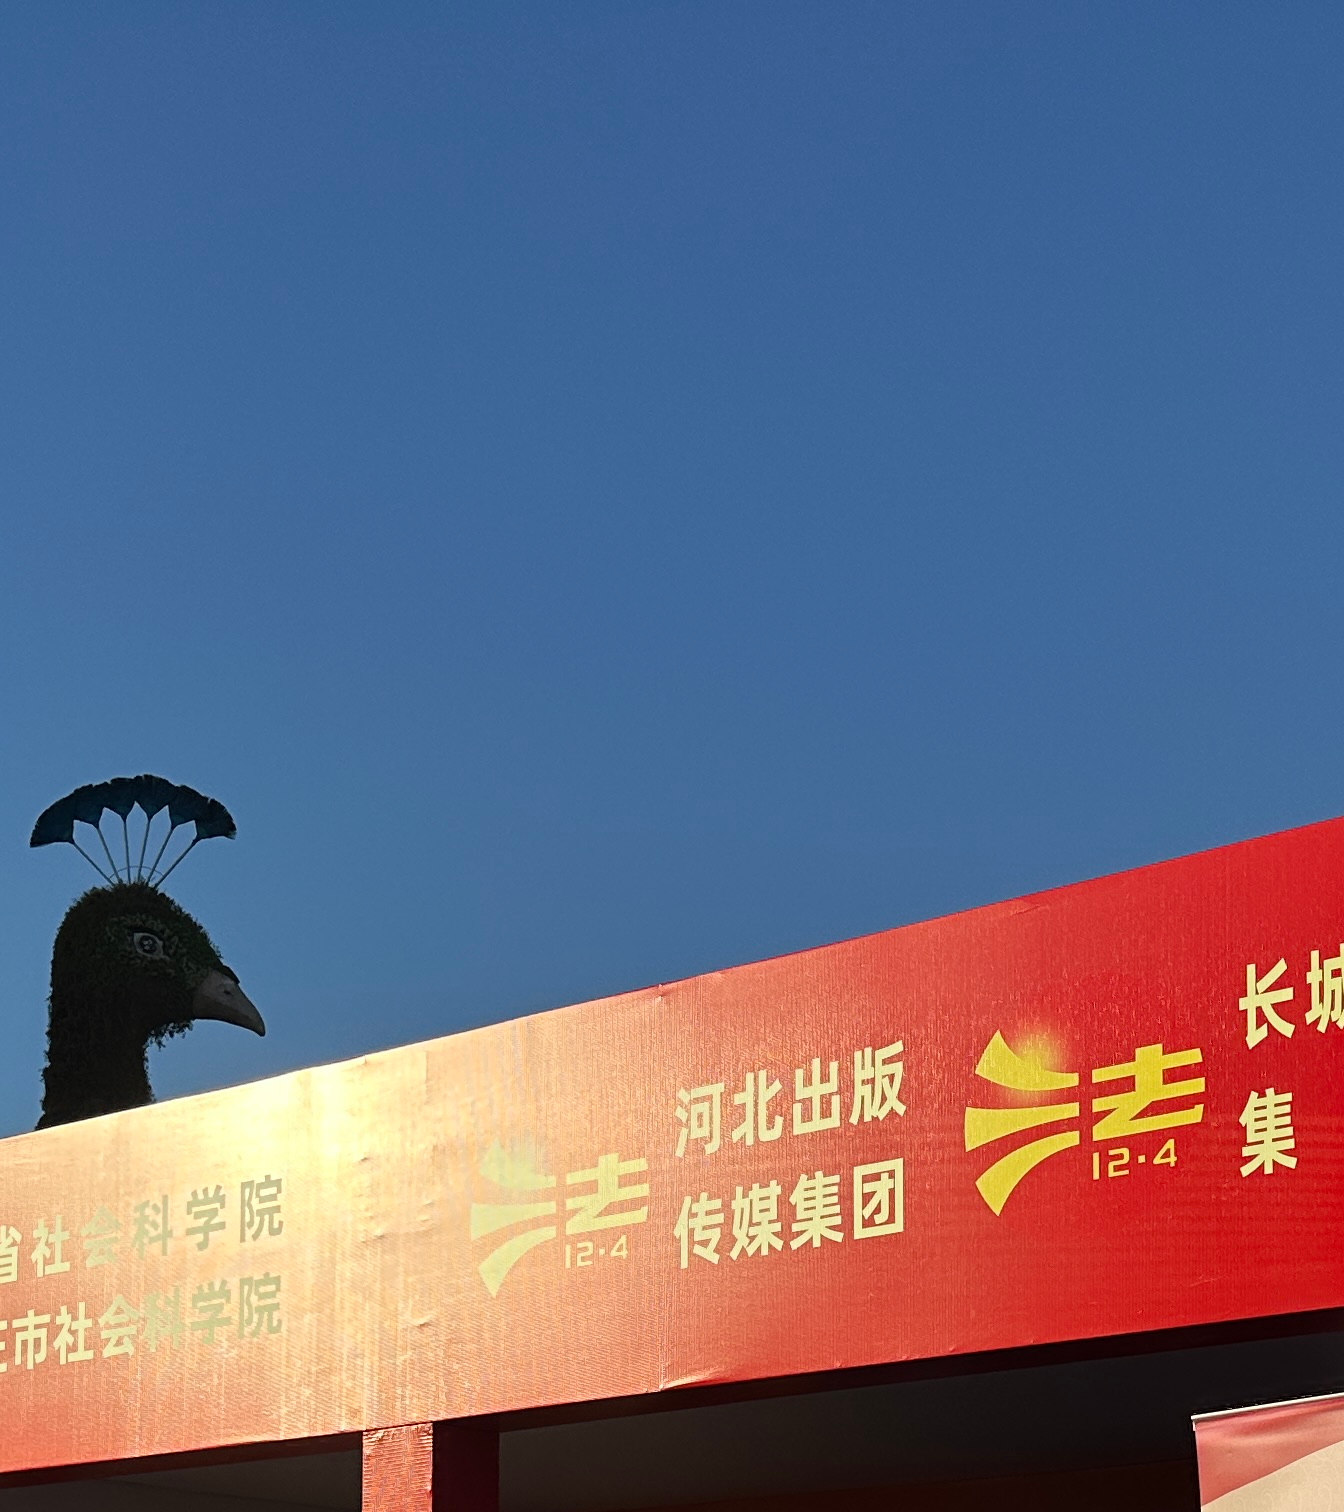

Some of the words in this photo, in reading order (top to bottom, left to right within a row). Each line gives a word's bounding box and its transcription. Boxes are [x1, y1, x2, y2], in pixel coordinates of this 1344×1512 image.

[675, 1041, 907, 1160] 河北出版
[674, 1158, 906, 1270] 传媒集团
